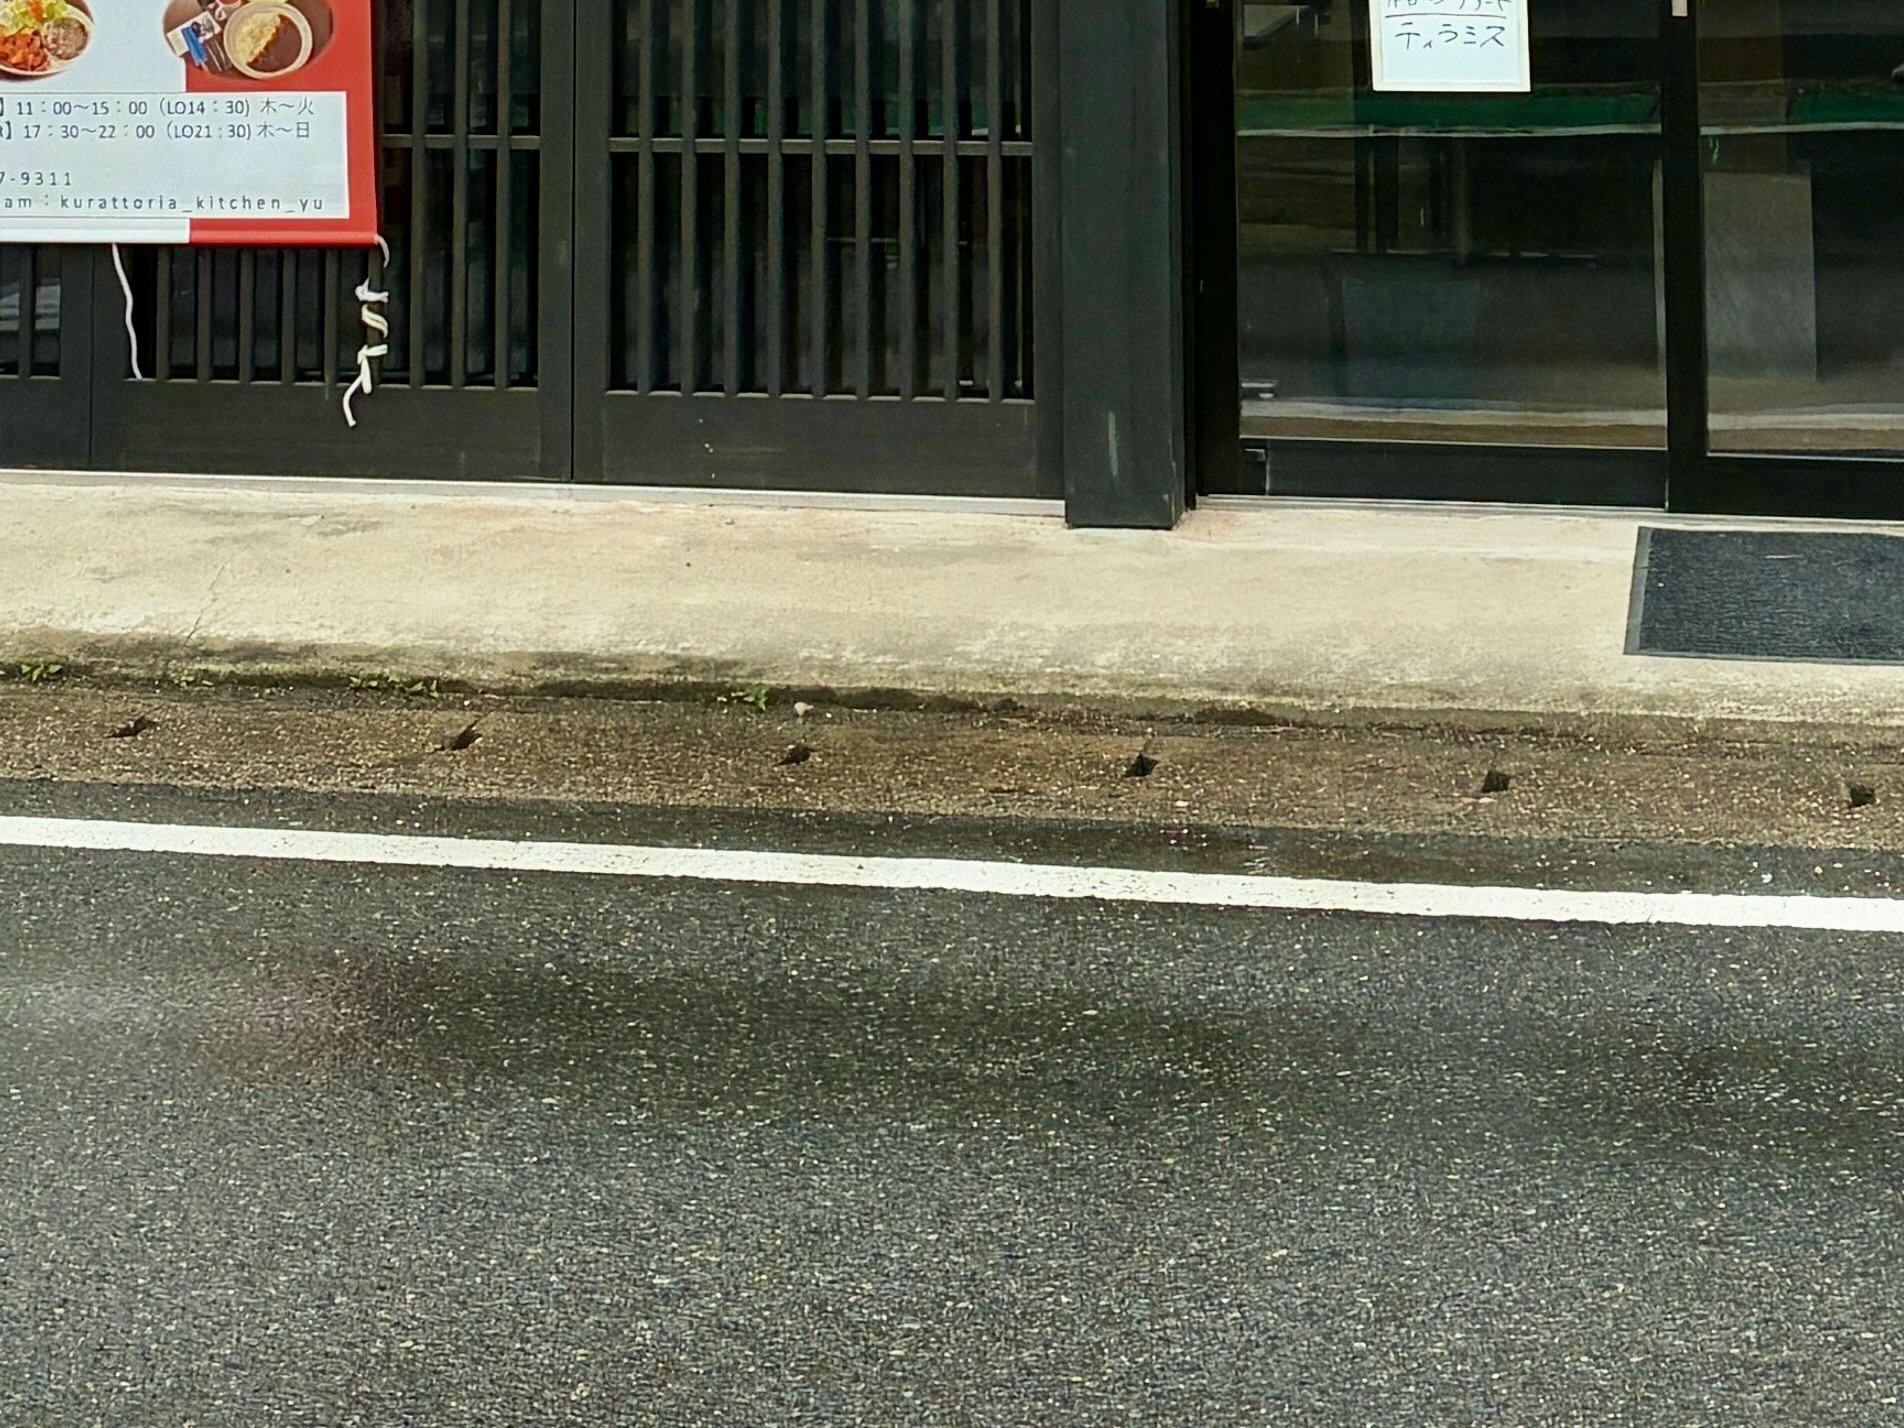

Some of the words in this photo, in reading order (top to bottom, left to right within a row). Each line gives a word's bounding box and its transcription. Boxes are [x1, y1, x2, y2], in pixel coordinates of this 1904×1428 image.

[1395, 22, 1506, 51] ティラミス
